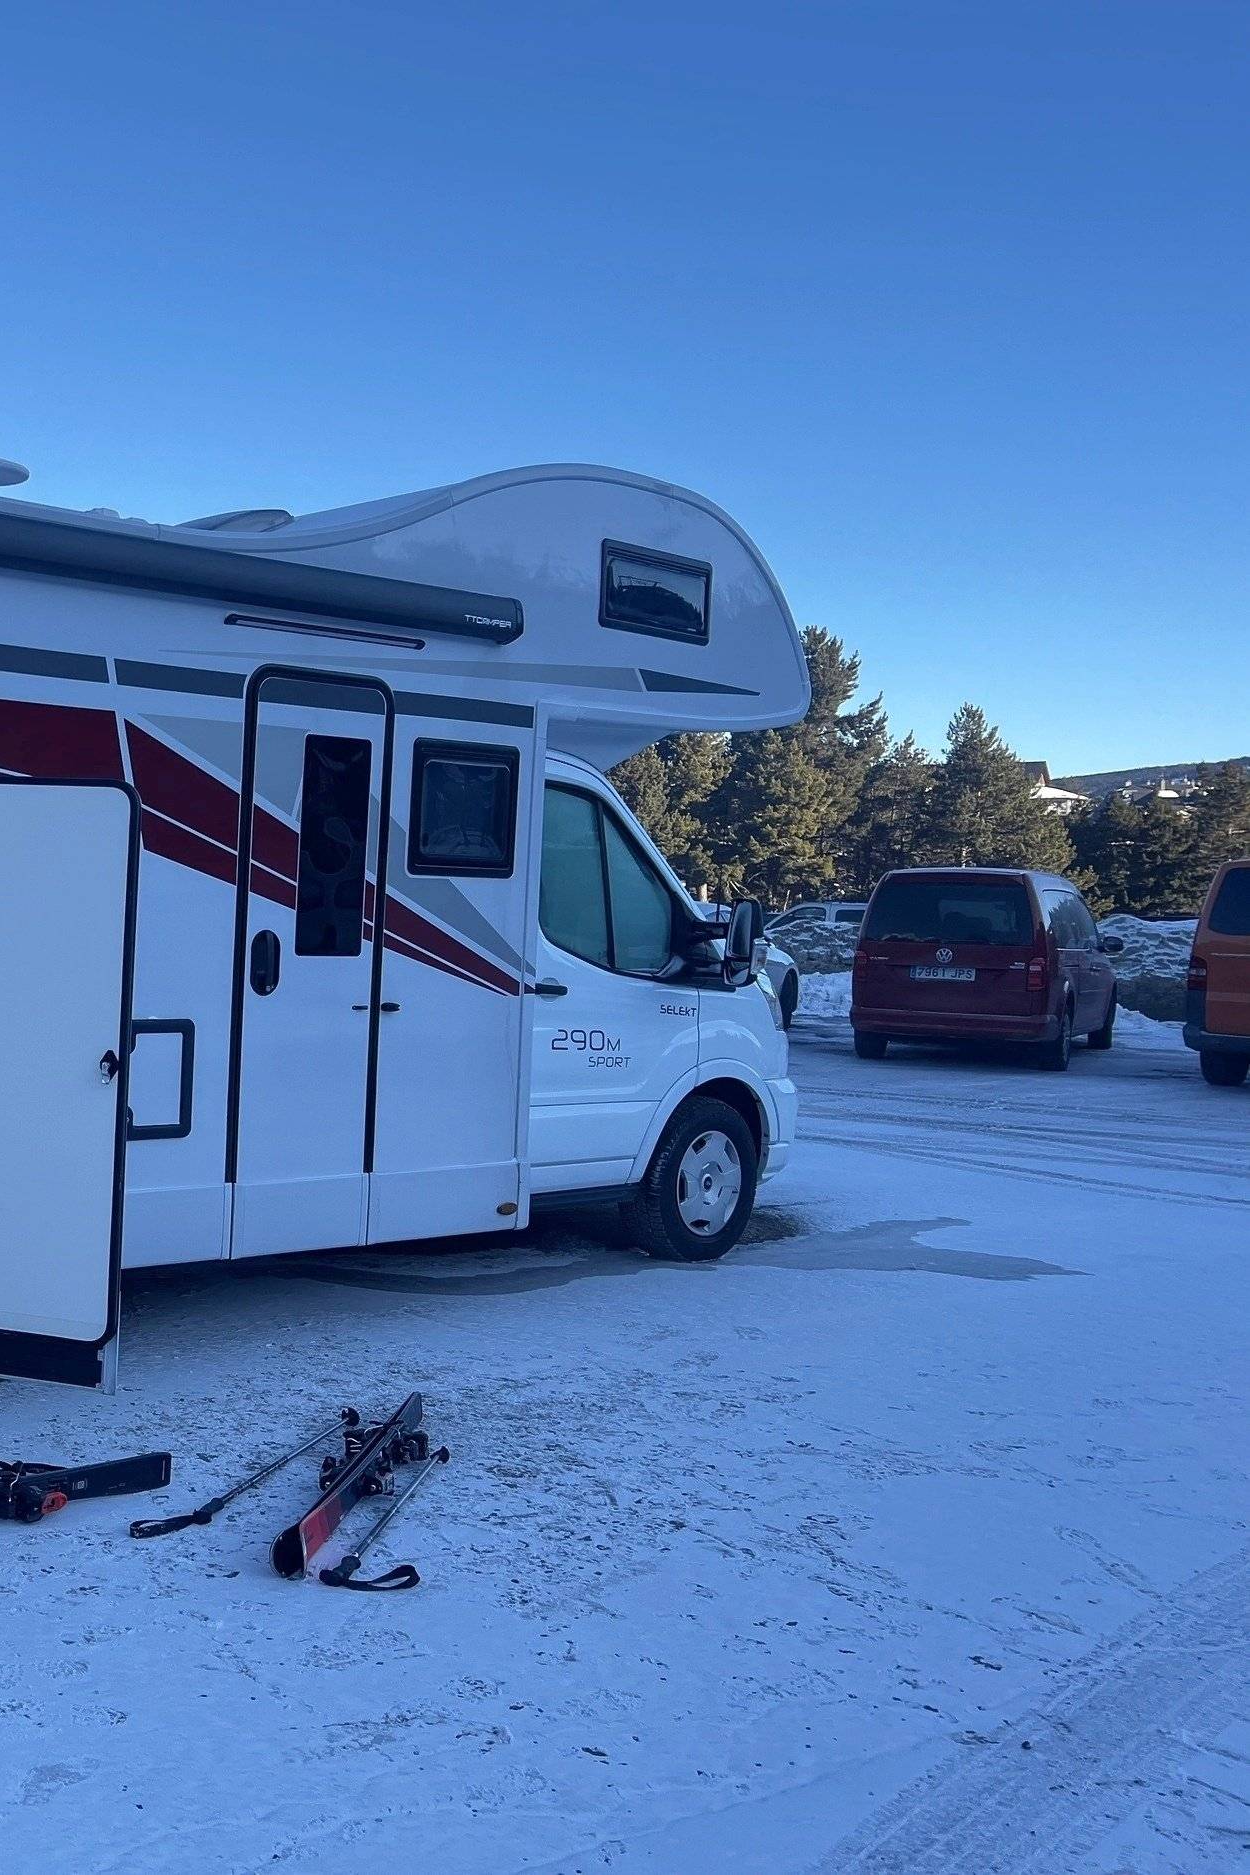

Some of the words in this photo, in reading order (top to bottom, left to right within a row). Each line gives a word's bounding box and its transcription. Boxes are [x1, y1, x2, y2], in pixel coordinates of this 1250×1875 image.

[950, 968, 973, 979] JPS
[660, 1004, 697, 1018] SELEKT
[588, 1056, 632, 1068] SPORT
